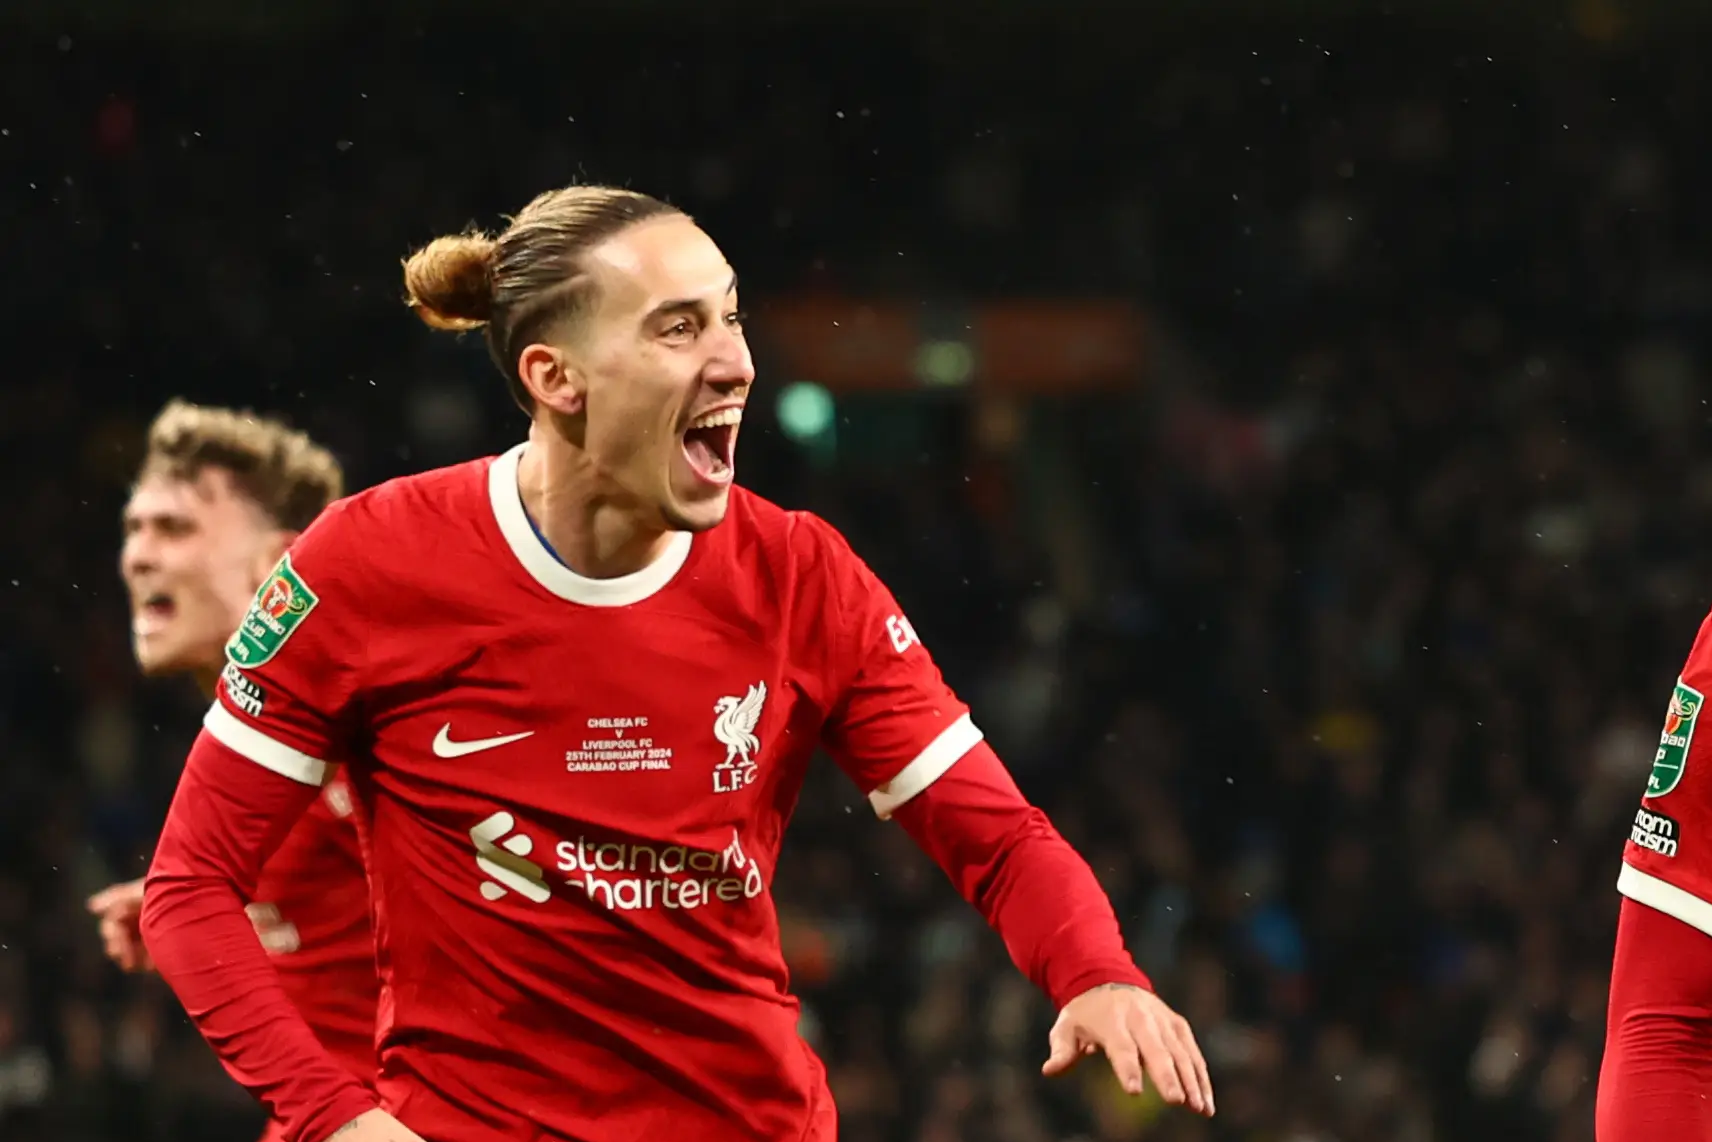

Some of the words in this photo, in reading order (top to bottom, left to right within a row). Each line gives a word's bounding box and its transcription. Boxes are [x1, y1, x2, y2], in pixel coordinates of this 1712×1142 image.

[587, 717, 633, 728] CHELSEA
[635, 716, 648, 727] FC
[582, 740, 637, 750] LIVERPOOL
[640, 738, 653, 748] FC
[566, 751, 592, 761] 25TH
[594, 749, 646, 760] FEBRUARY
[648, 748, 672, 759] 2024
[567, 761, 616, 771] CARABAO
[618, 761, 639, 771] CUP
[641, 760, 671, 770] FINAL
[556, 825, 746, 875] standard
